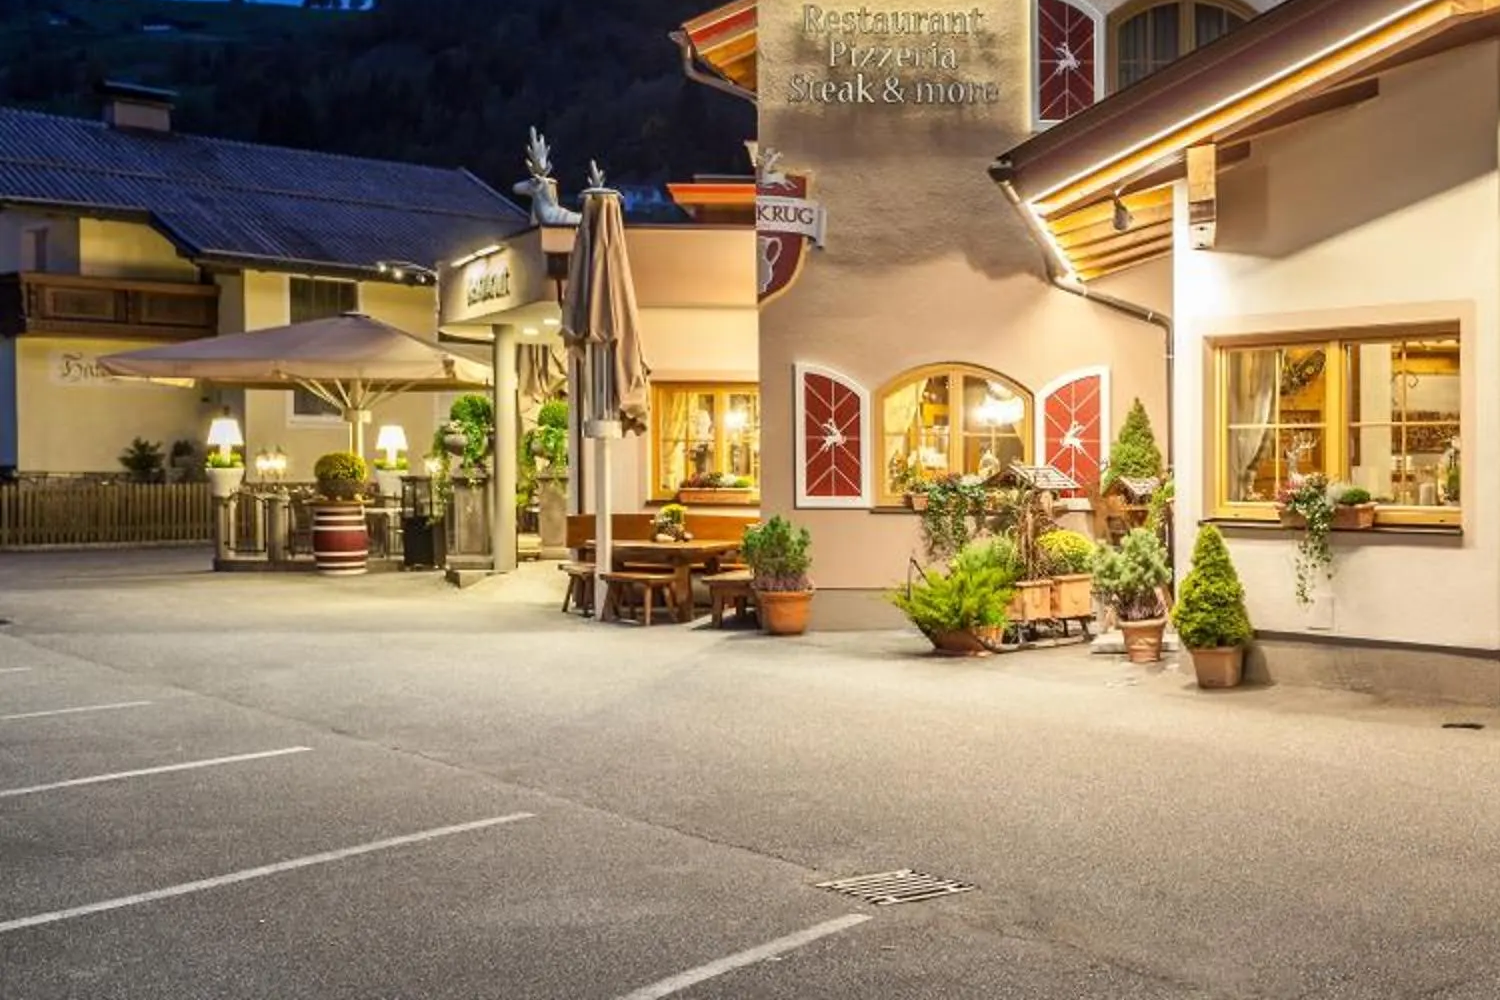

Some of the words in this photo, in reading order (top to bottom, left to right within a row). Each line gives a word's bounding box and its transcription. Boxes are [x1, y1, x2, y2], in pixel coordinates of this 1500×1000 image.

[802, 3, 985, 36] Restaurant
[829, 39, 958, 69] Pizzeria
[789, 73, 875, 104] Steak
[883, 75, 905, 104] &
[916, 80, 1000, 105] more
[757, 204, 814, 225] KRUG
